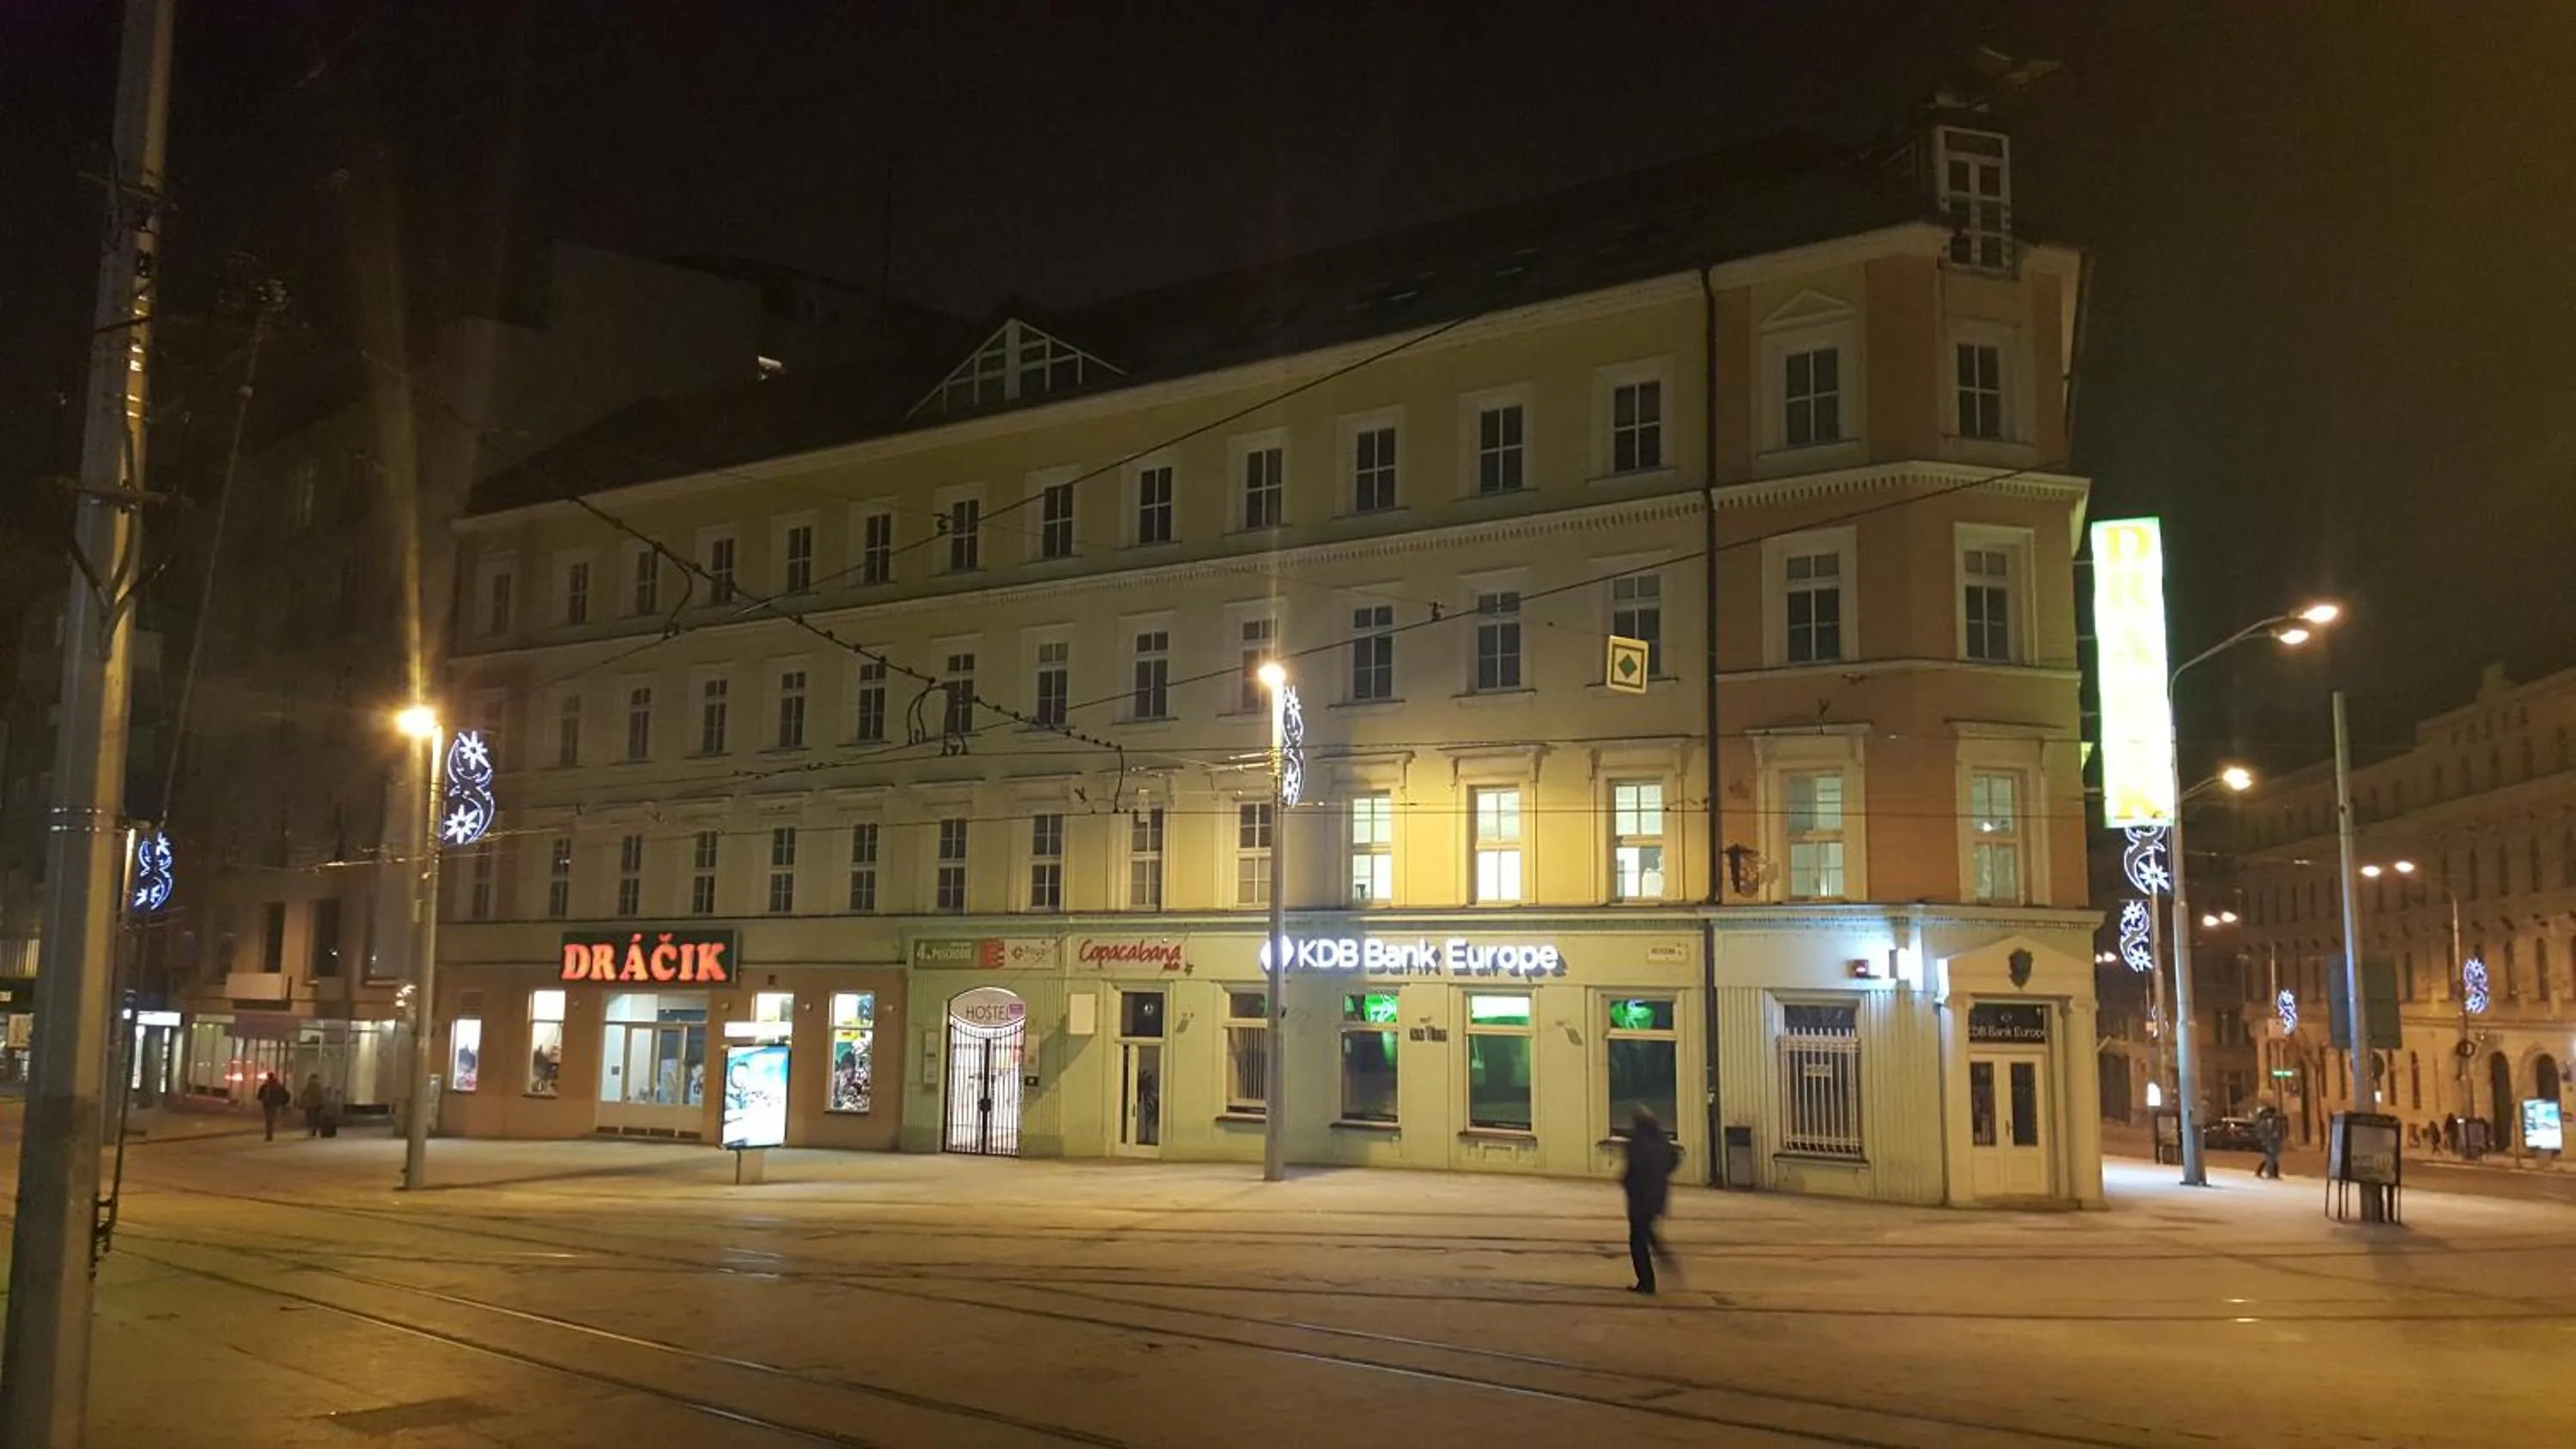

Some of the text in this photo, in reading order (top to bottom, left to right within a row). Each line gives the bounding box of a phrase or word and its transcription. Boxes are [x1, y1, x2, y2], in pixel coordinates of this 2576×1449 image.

[2104, 524, 2170, 821] DRK
[562, 933, 726, 981] DRÁČIK
[1078, 938, 1182, 970] Copacabana
[1297, 936, 1559, 976] KDB Bank Europe
[966, 1003, 1011, 1021] HOSTEL
[1968, 1024, 1986, 1037] DB
[1988, 1024, 2011, 1038] Bank
